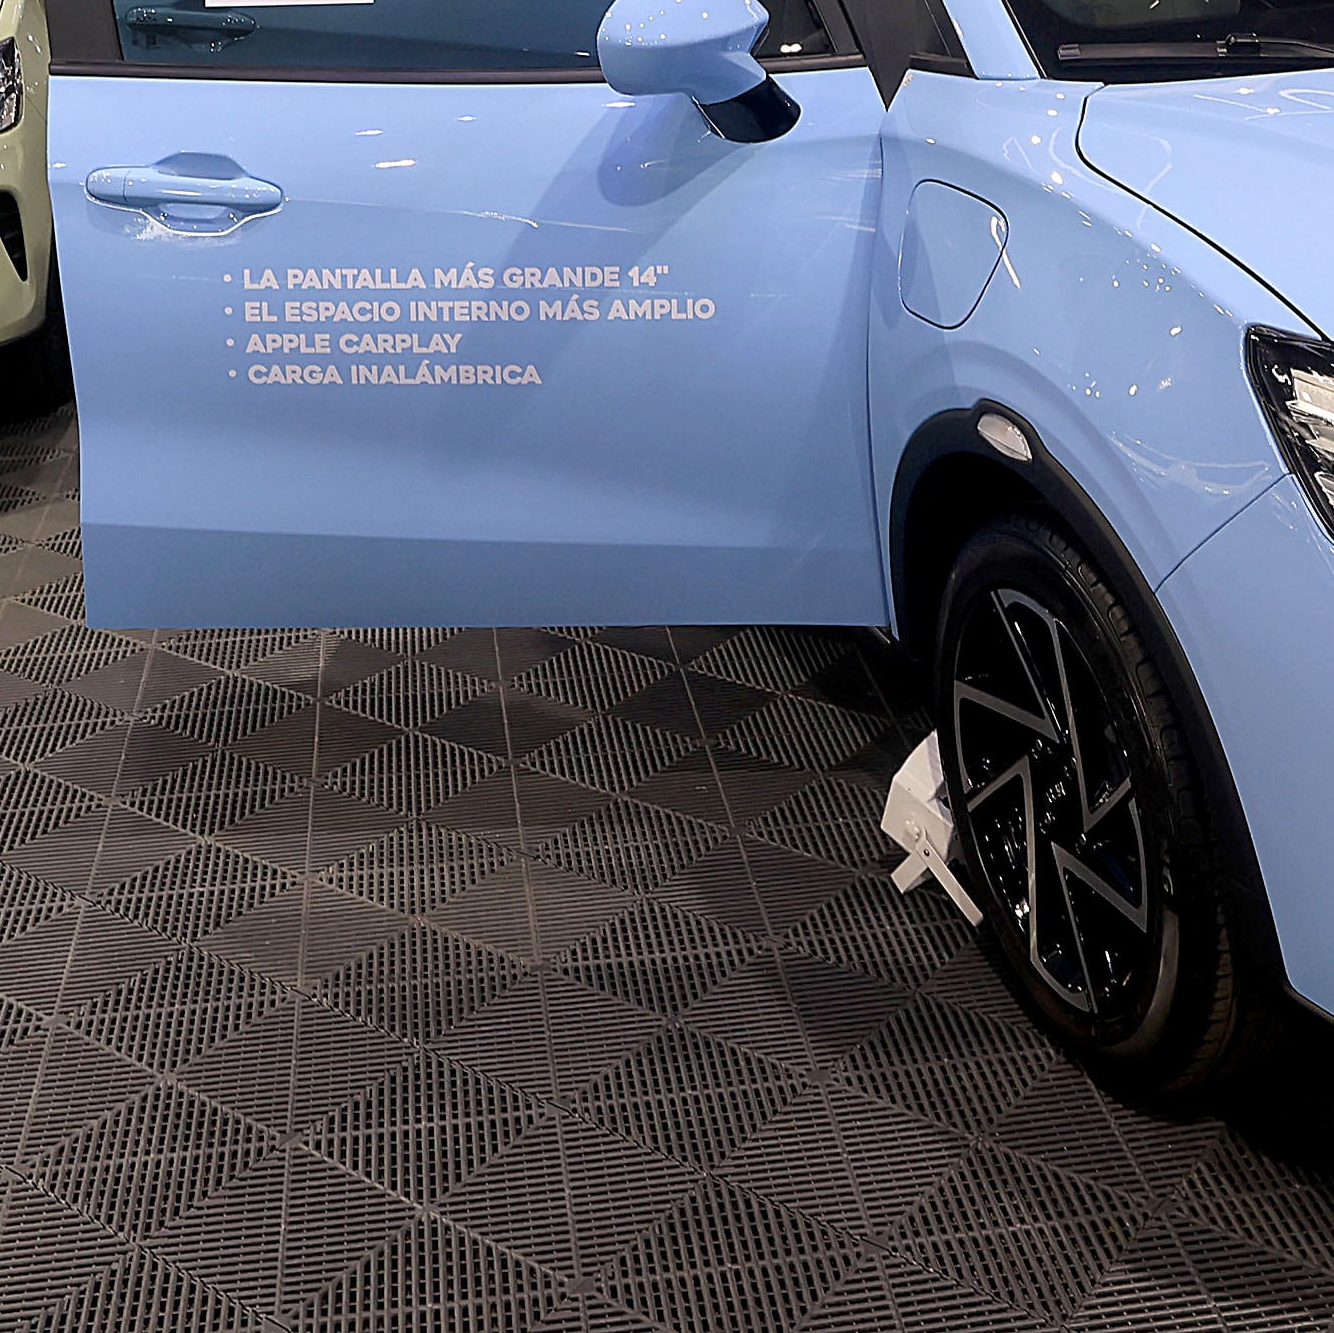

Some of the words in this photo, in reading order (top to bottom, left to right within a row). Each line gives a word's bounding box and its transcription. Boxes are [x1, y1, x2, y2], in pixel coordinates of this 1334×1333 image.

[243, 268, 279, 290] LA
[287, 267, 426, 290] PANTALLA
[434, 261, 495, 289] MÁS
[503, 266, 620, 289] GRANDE
[244, 300, 278, 322] EL
[285, 299, 401, 322] ESPACIO
[409, 299, 532, 322] INTERNO
[539, 293, 600, 321] MÁS
[607, 297, 717, 321] AMPLIO
[245, 333, 331, 354] APPLE
[339, 332, 463, 354] CARPLAY
[247, 364, 343, 385] CARGA
[350, 359, 543, 386] INALÁMBRICA
